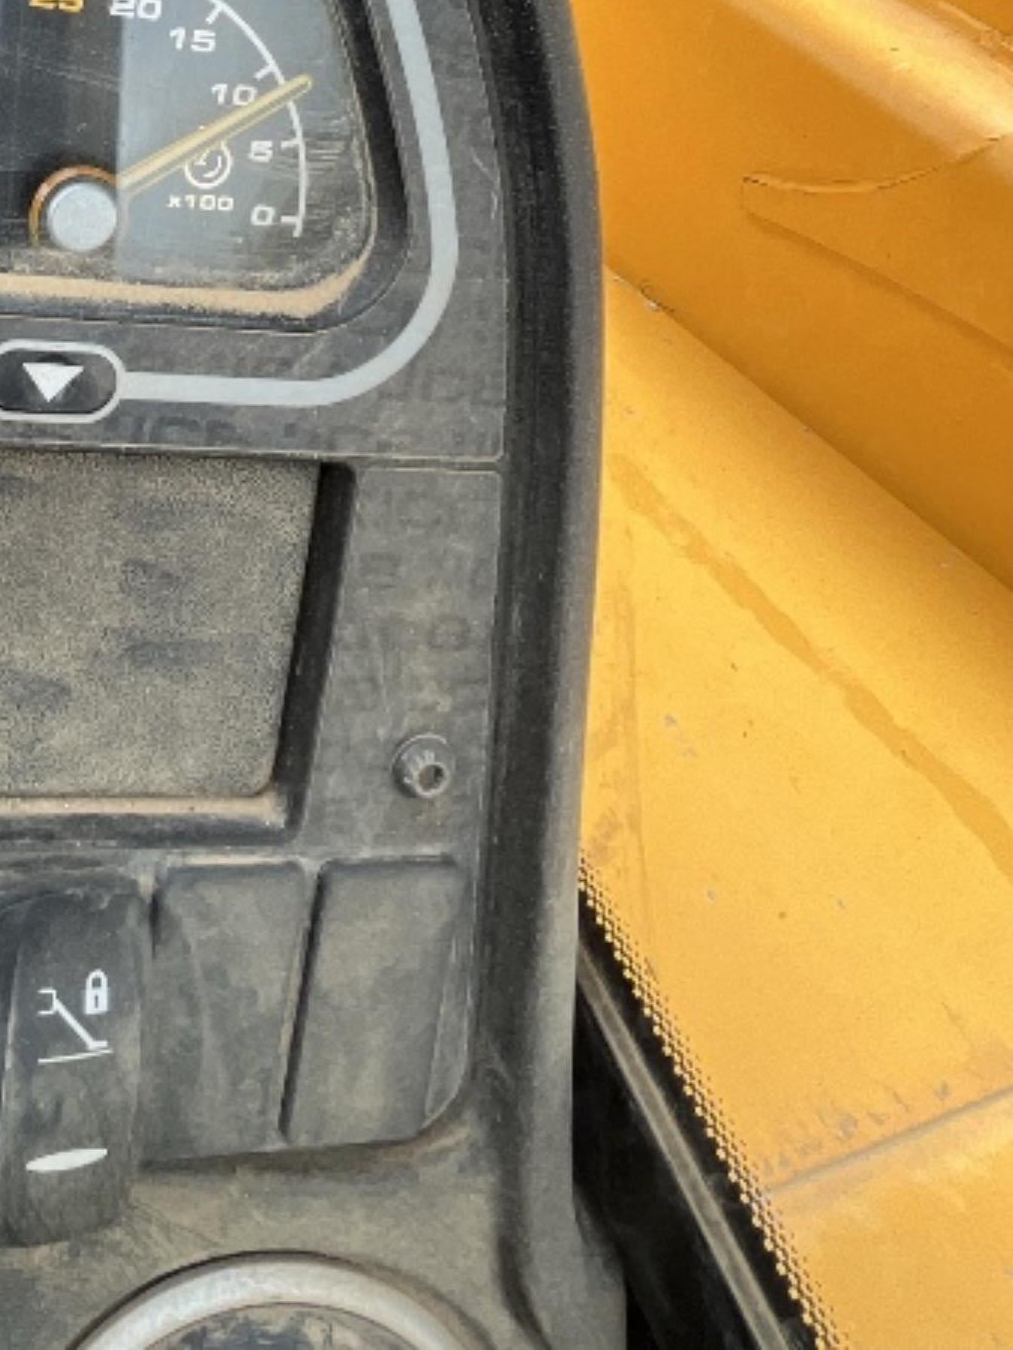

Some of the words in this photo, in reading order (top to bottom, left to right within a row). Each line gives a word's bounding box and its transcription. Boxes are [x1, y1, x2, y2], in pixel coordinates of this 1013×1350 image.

[169, 26, 217, 52] 15
[210, 83, 257, 107] 10
[248, 139, 274, 163] 5
[250, 203, 276, 227] 0
